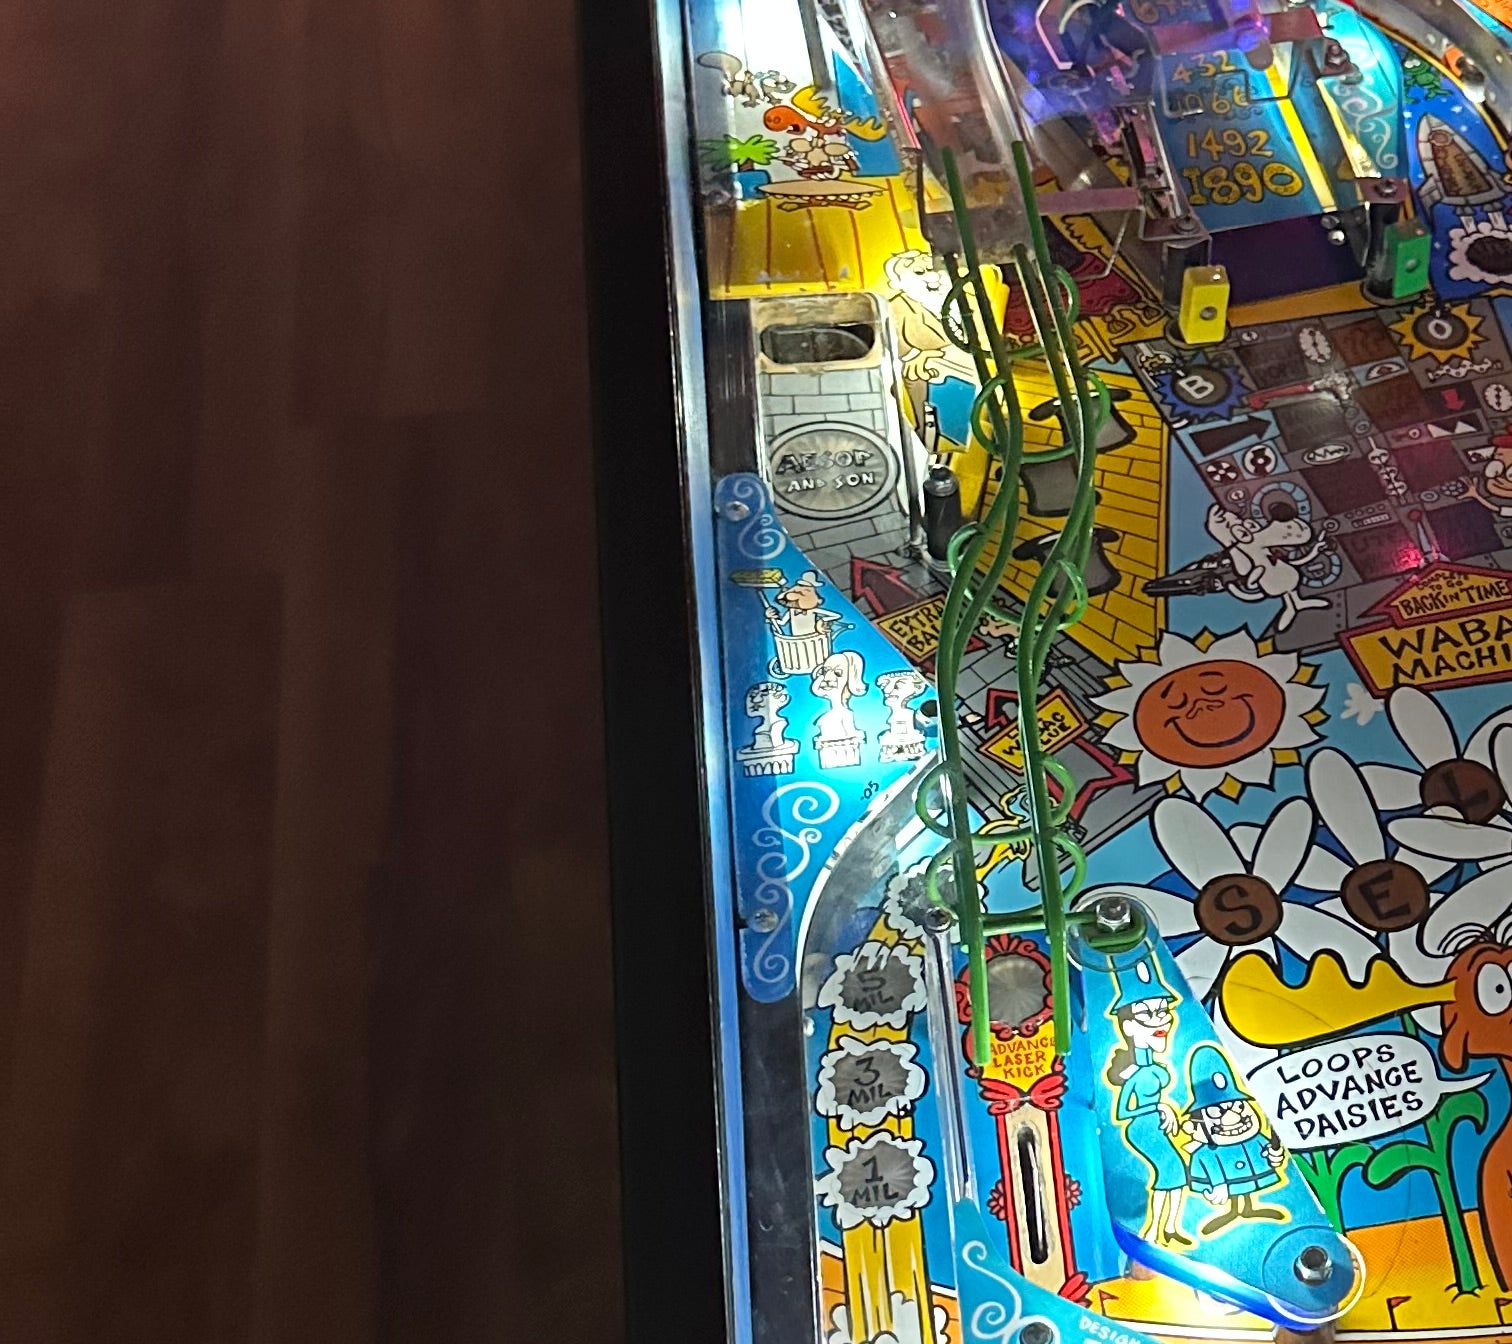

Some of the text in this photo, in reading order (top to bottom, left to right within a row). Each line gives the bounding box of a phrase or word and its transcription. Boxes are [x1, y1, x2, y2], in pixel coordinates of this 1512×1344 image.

[1171, 49, 1237, 84] 432
[1187, 128, 1274, 162] 1492
[1190, 374, 1216, 400] B
[775, 449, 874, 475] AESOP
[787, 471, 875, 494] AND SON
[1399, 580, 1511, 617] BACK IN TIME
[1429, 577, 1464, 592] TO GO
[906, 622, 941, 653] BA
[1216, 882, 1261, 938] S
[1361, 868, 1411, 920] E
[1442, 772, 1490, 806] L
[855, 968, 887, 992] 5
[852, 989, 896, 1013] MIL
[854, 1056, 881, 1087] 3
[992, 1051, 1048, 1069] LASER
[1002, 1064, 1047, 1080] KICK
[1276, 1043, 1397, 1084] LOOPS
[847, 1082, 892, 1106] MIL
[1274, 1060, 1425, 1123] ADVANCE
[1293, 1089, 1425, 1143] DAISIES
[862, 1154, 884, 1185] 1
[852, 1183, 900, 1206] MIL
